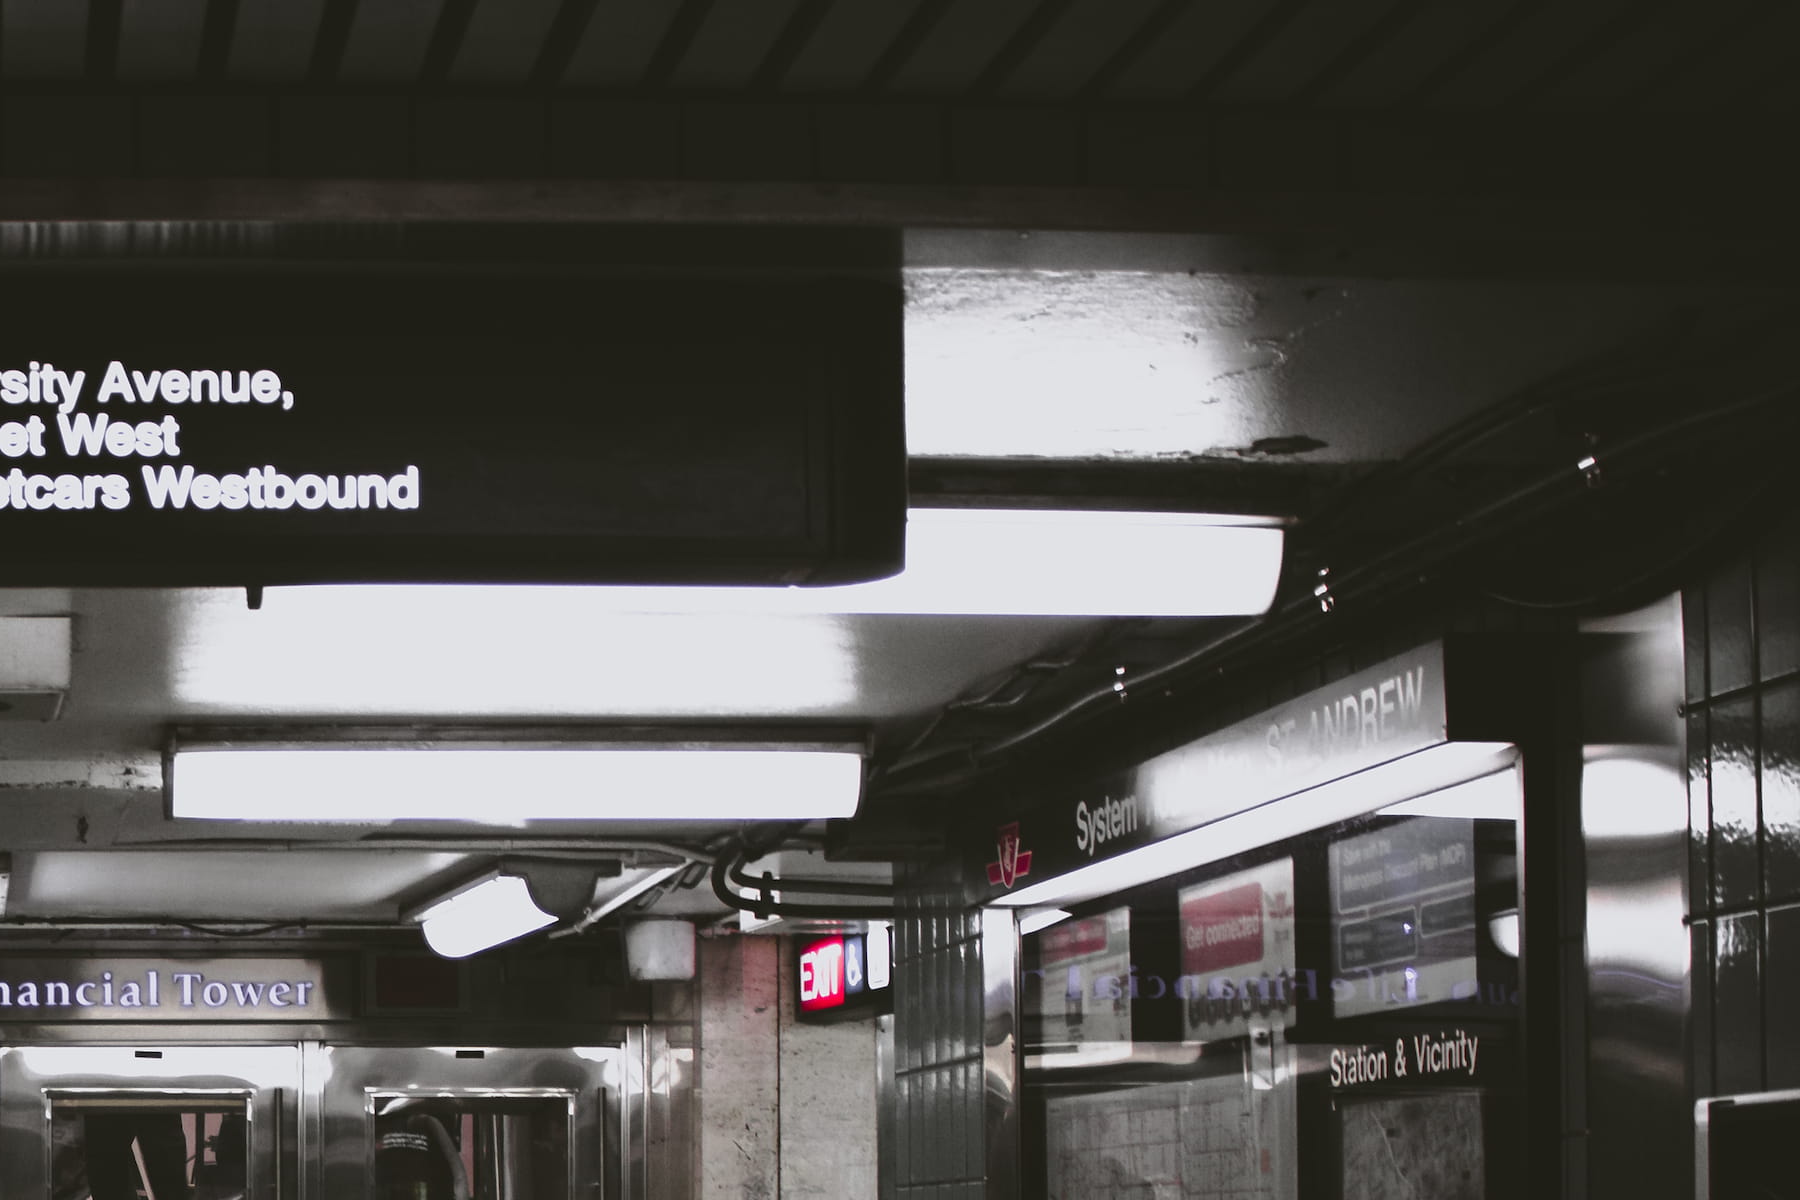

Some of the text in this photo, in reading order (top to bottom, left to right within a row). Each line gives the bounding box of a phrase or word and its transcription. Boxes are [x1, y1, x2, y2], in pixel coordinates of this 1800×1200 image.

[98, 361, 294, 409] Avenue,
[57, 413, 180, 456] West
[142, 465, 419, 510] Westbound
[1308, 666, 1423, 755] ANDREW
[1076, 795, 1137, 856] System
[1186, 923, 1204, 950] Get
[1206, 908, 1260, 946] connected
[174, 971, 314, 1007] Tower
[800, 943, 842, 1002] EXIT
[1330, 1030, 1478, 1086] Station & Vicinity
